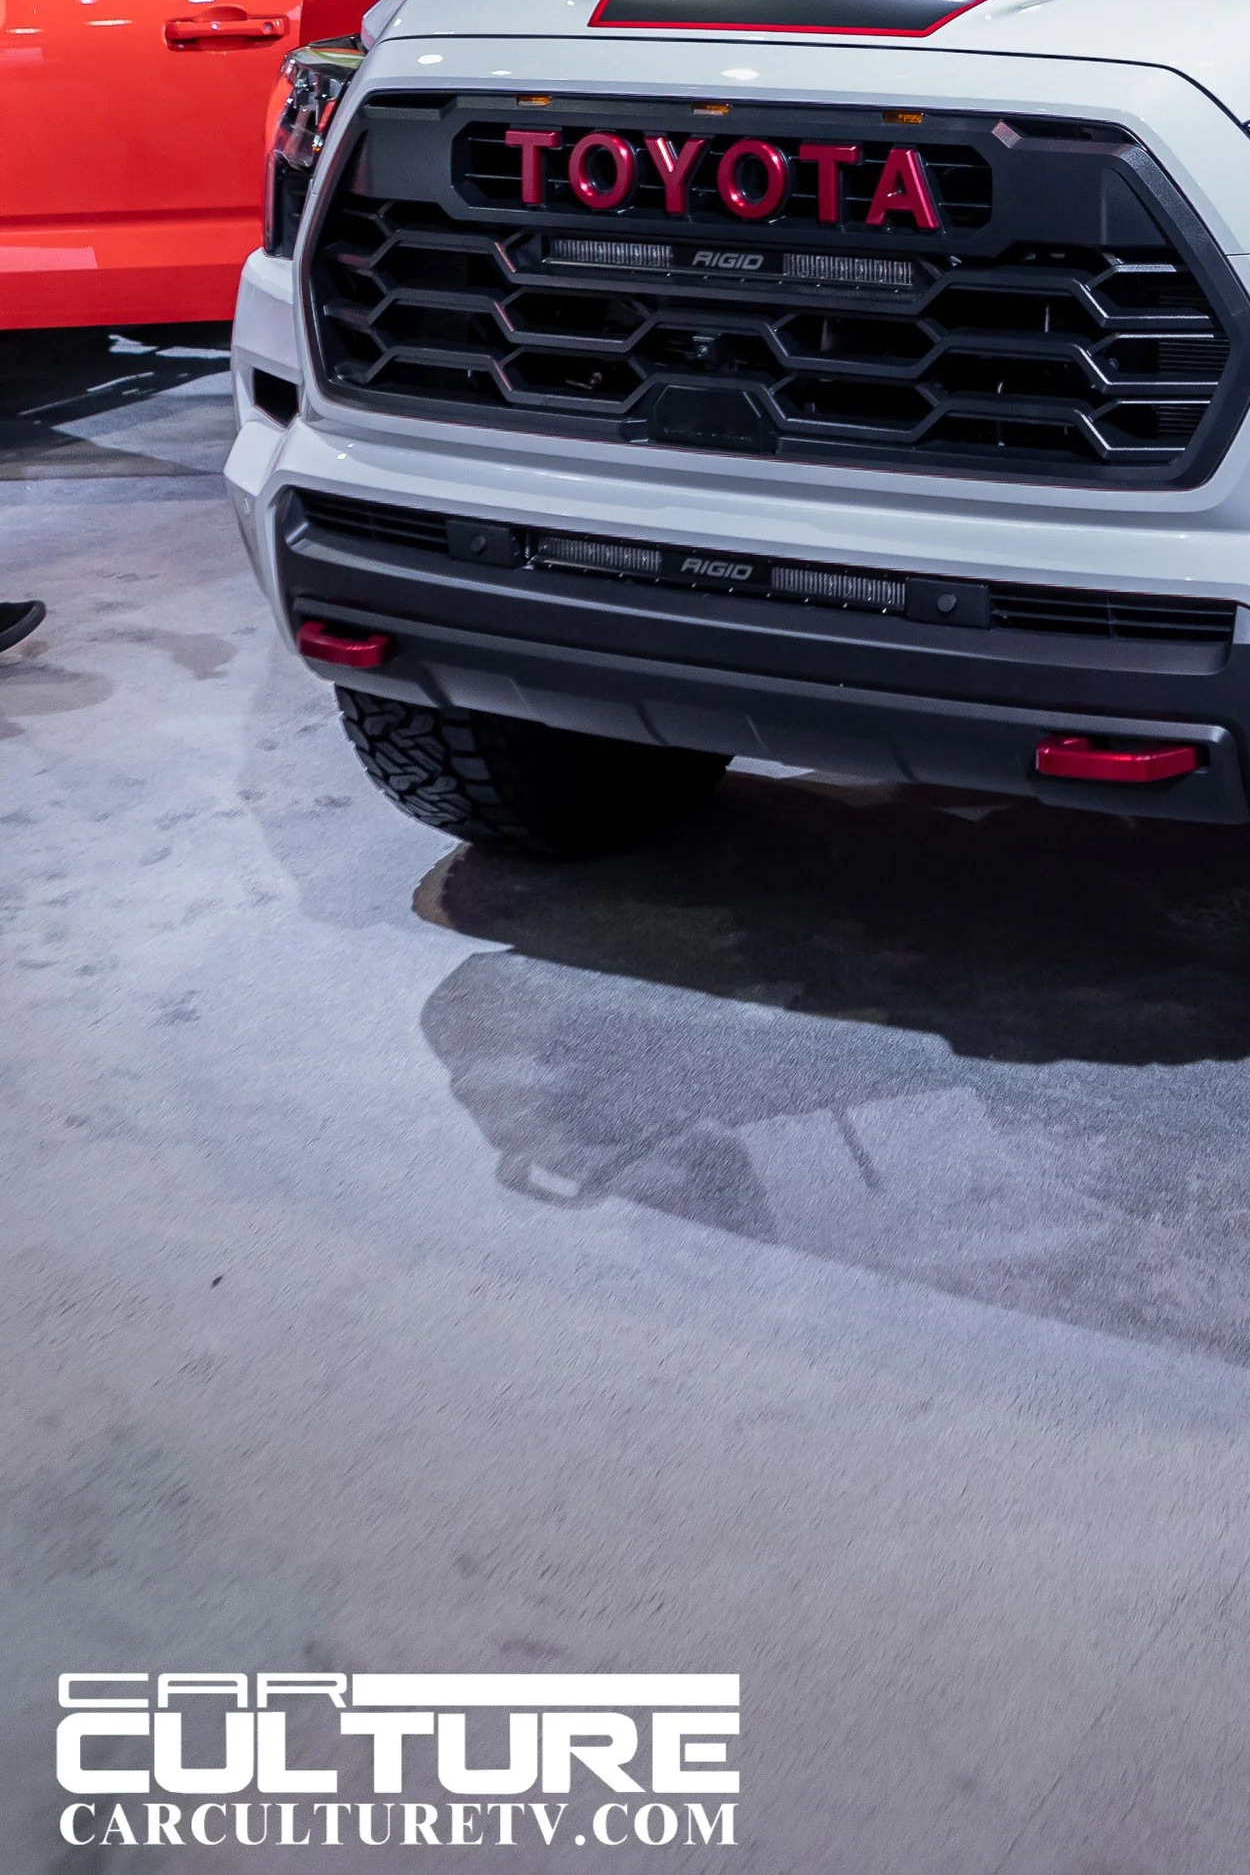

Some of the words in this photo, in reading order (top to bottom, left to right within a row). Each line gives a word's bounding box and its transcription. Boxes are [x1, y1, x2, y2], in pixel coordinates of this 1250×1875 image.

[504, 128, 940, 231] TOYOTA
[692, 250, 764, 271] RIGID
[680, 557, 754, 581] RIGID
